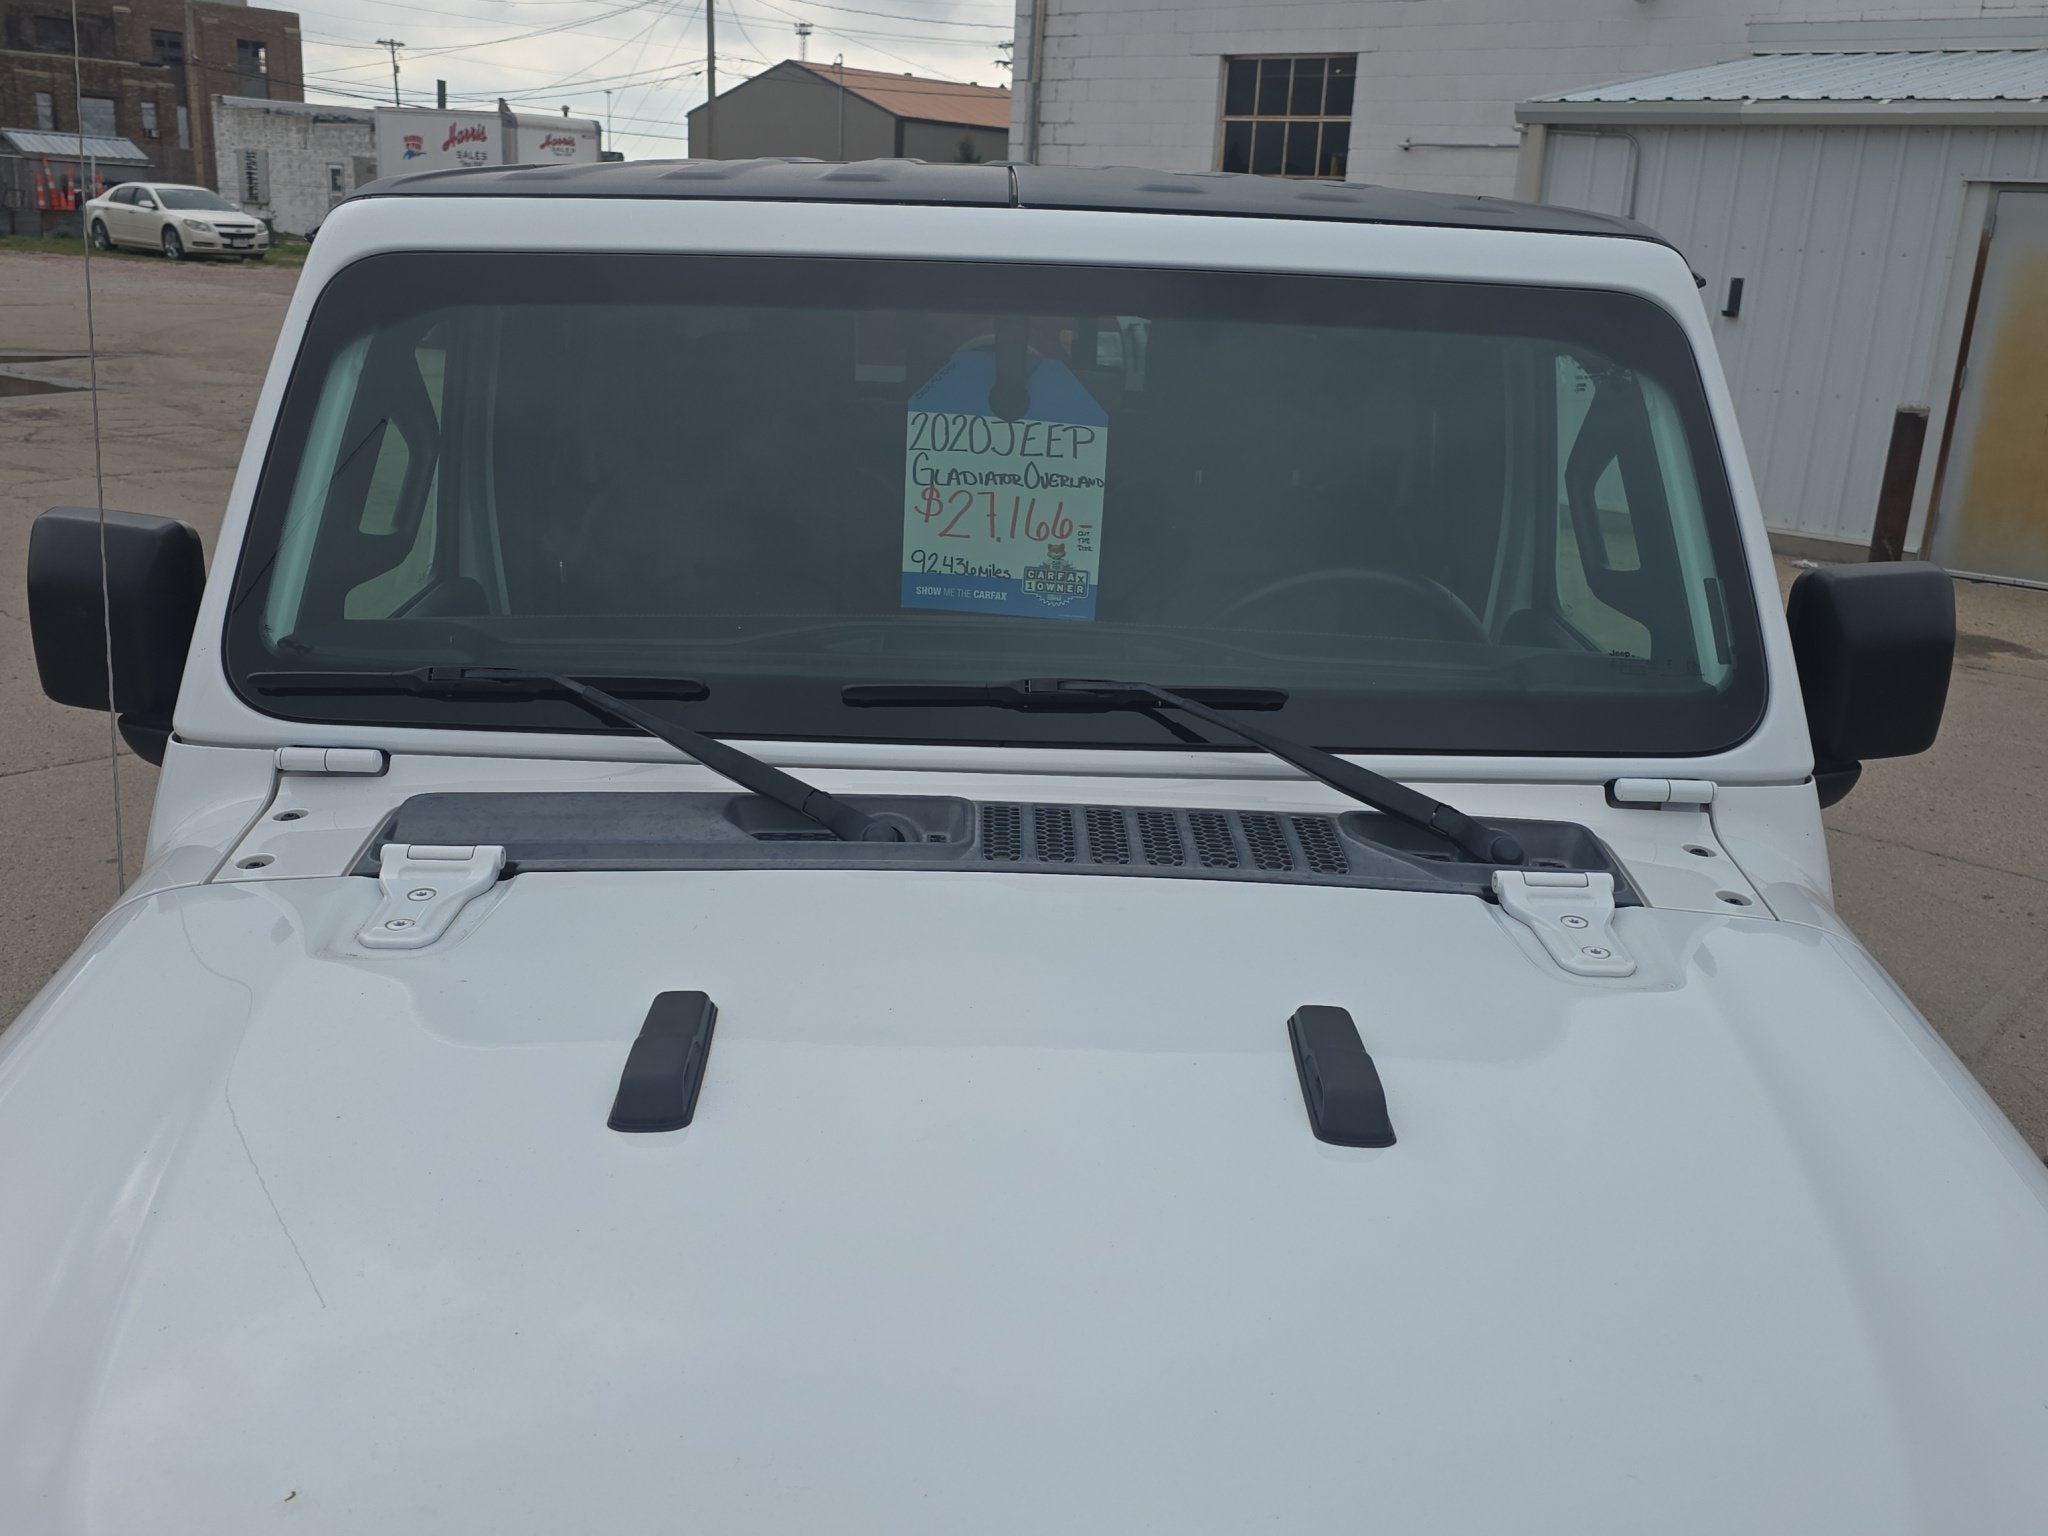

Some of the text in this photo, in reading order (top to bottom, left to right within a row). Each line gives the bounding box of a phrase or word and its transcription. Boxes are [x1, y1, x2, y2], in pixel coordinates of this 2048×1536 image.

[456, 150, 488, 161] SALES
[908, 412, 1095, 459] 2020 JEEP
[1027, 570, 1085, 584] CARFAX
[915, 586, 1008, 601] SHOW ME THE CARFAX
[1037, 582, 1085, 594] OWNER
[1608, 649, 1631, 658] Jeep
